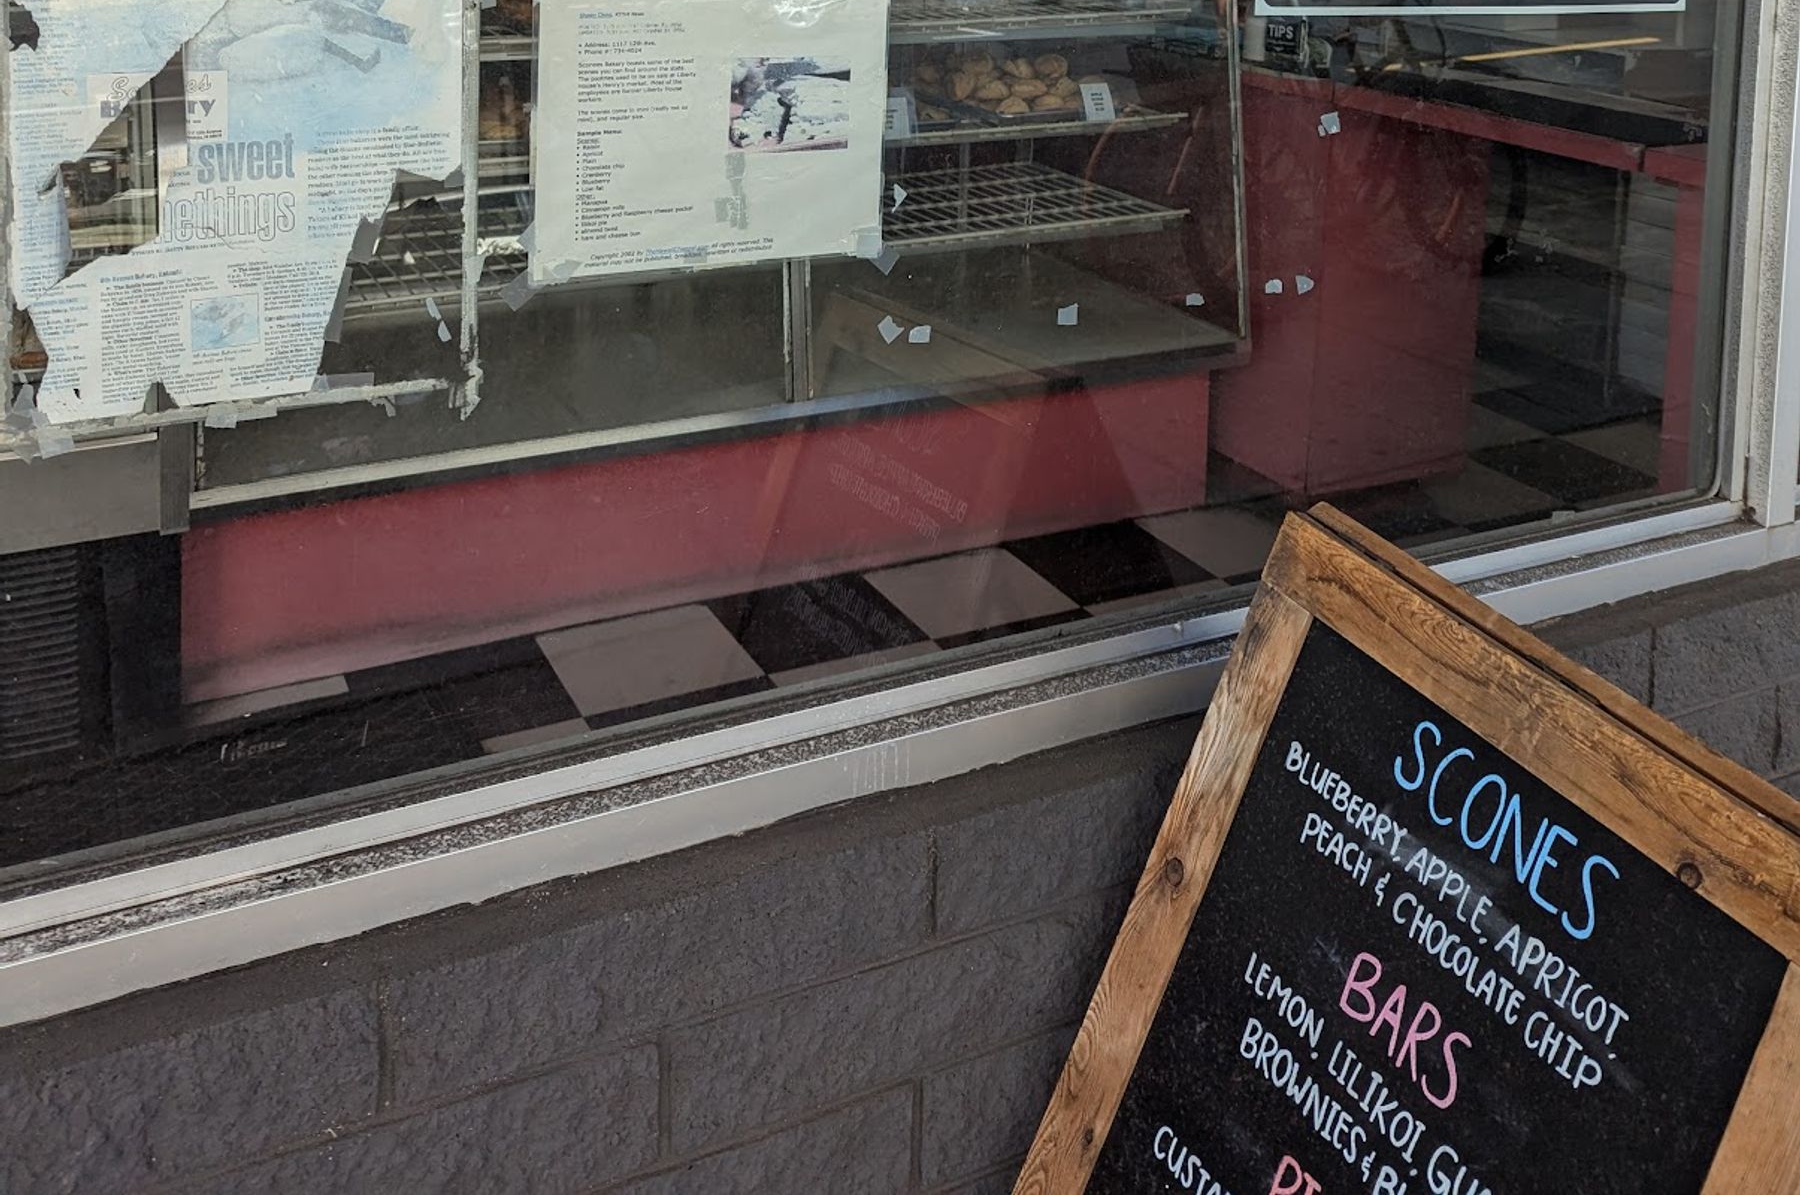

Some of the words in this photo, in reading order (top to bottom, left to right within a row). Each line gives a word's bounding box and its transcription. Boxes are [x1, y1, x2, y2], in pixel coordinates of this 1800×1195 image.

[1267, 23, 1295, 40] TIPS
[197, 133, 295, 184] sweet
[1394, 720, 1620, 940] SCONES
[1300, 811, 1374, 888] PEACH
[1374, 872, 1391, 907] &
[1392, 892, 1526, 1025] CHOCOLATE
[1523, 1011, 1603, 1090] CHIP
[1339, 952, 1473, 1109] BARS
[1240, 1017, 1367, 1164] BROWNIES
[1361, 1150, 1377, 1182] &
